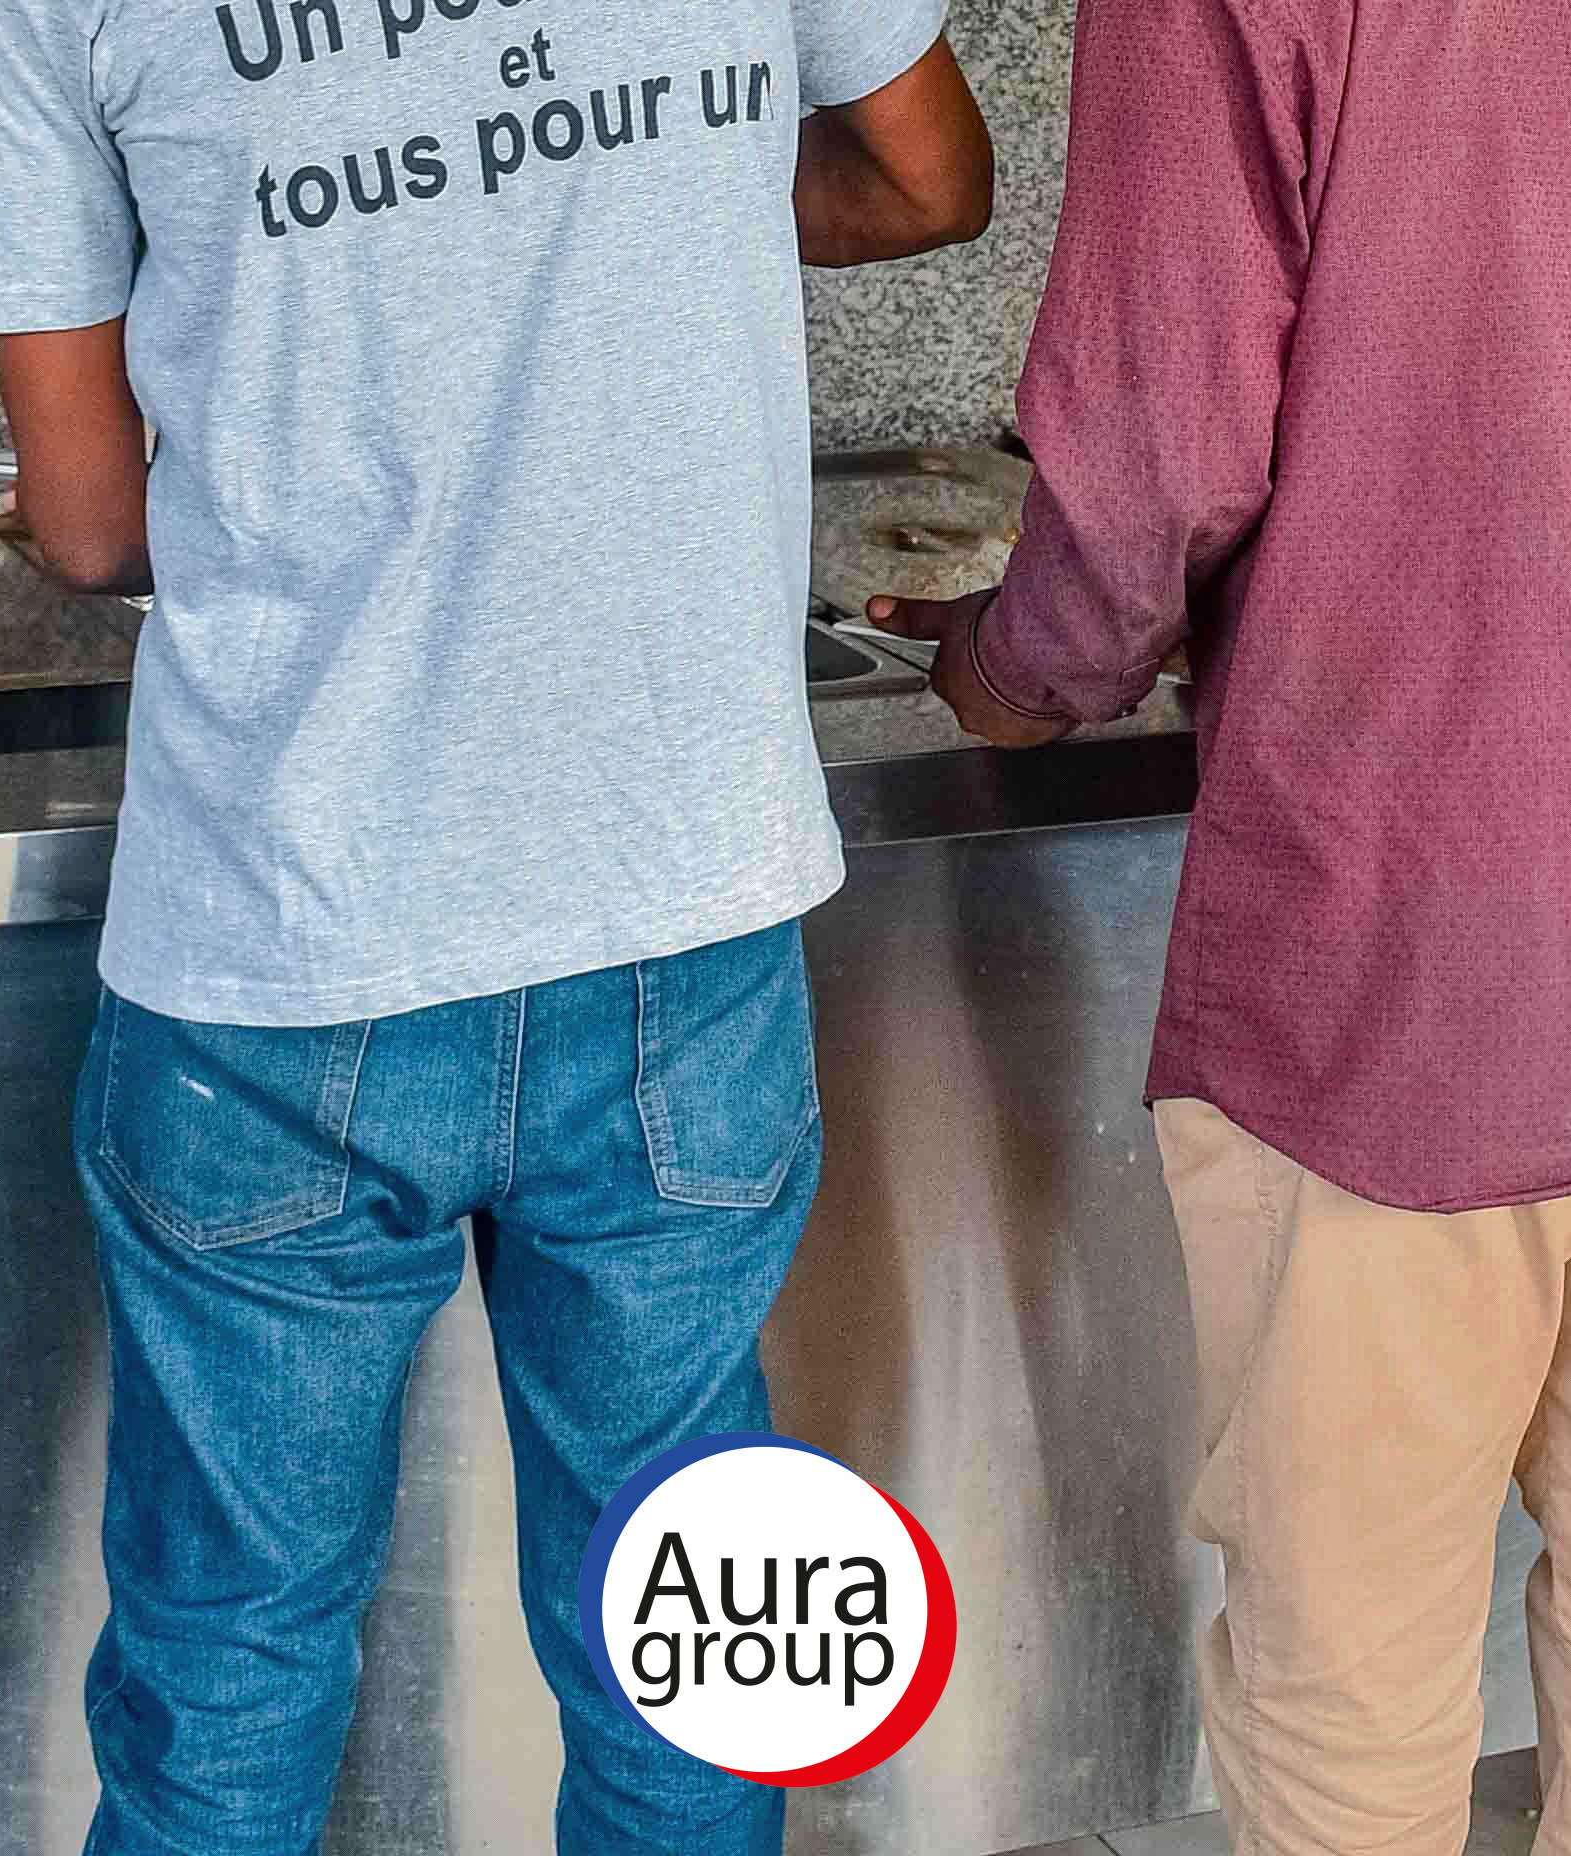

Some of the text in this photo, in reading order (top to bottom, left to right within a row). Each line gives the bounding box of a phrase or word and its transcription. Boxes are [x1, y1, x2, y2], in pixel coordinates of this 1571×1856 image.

[499, 27, 556, 89] et
[254, 135, 448, 238] tous
[475, 75, 671, 196] pour
